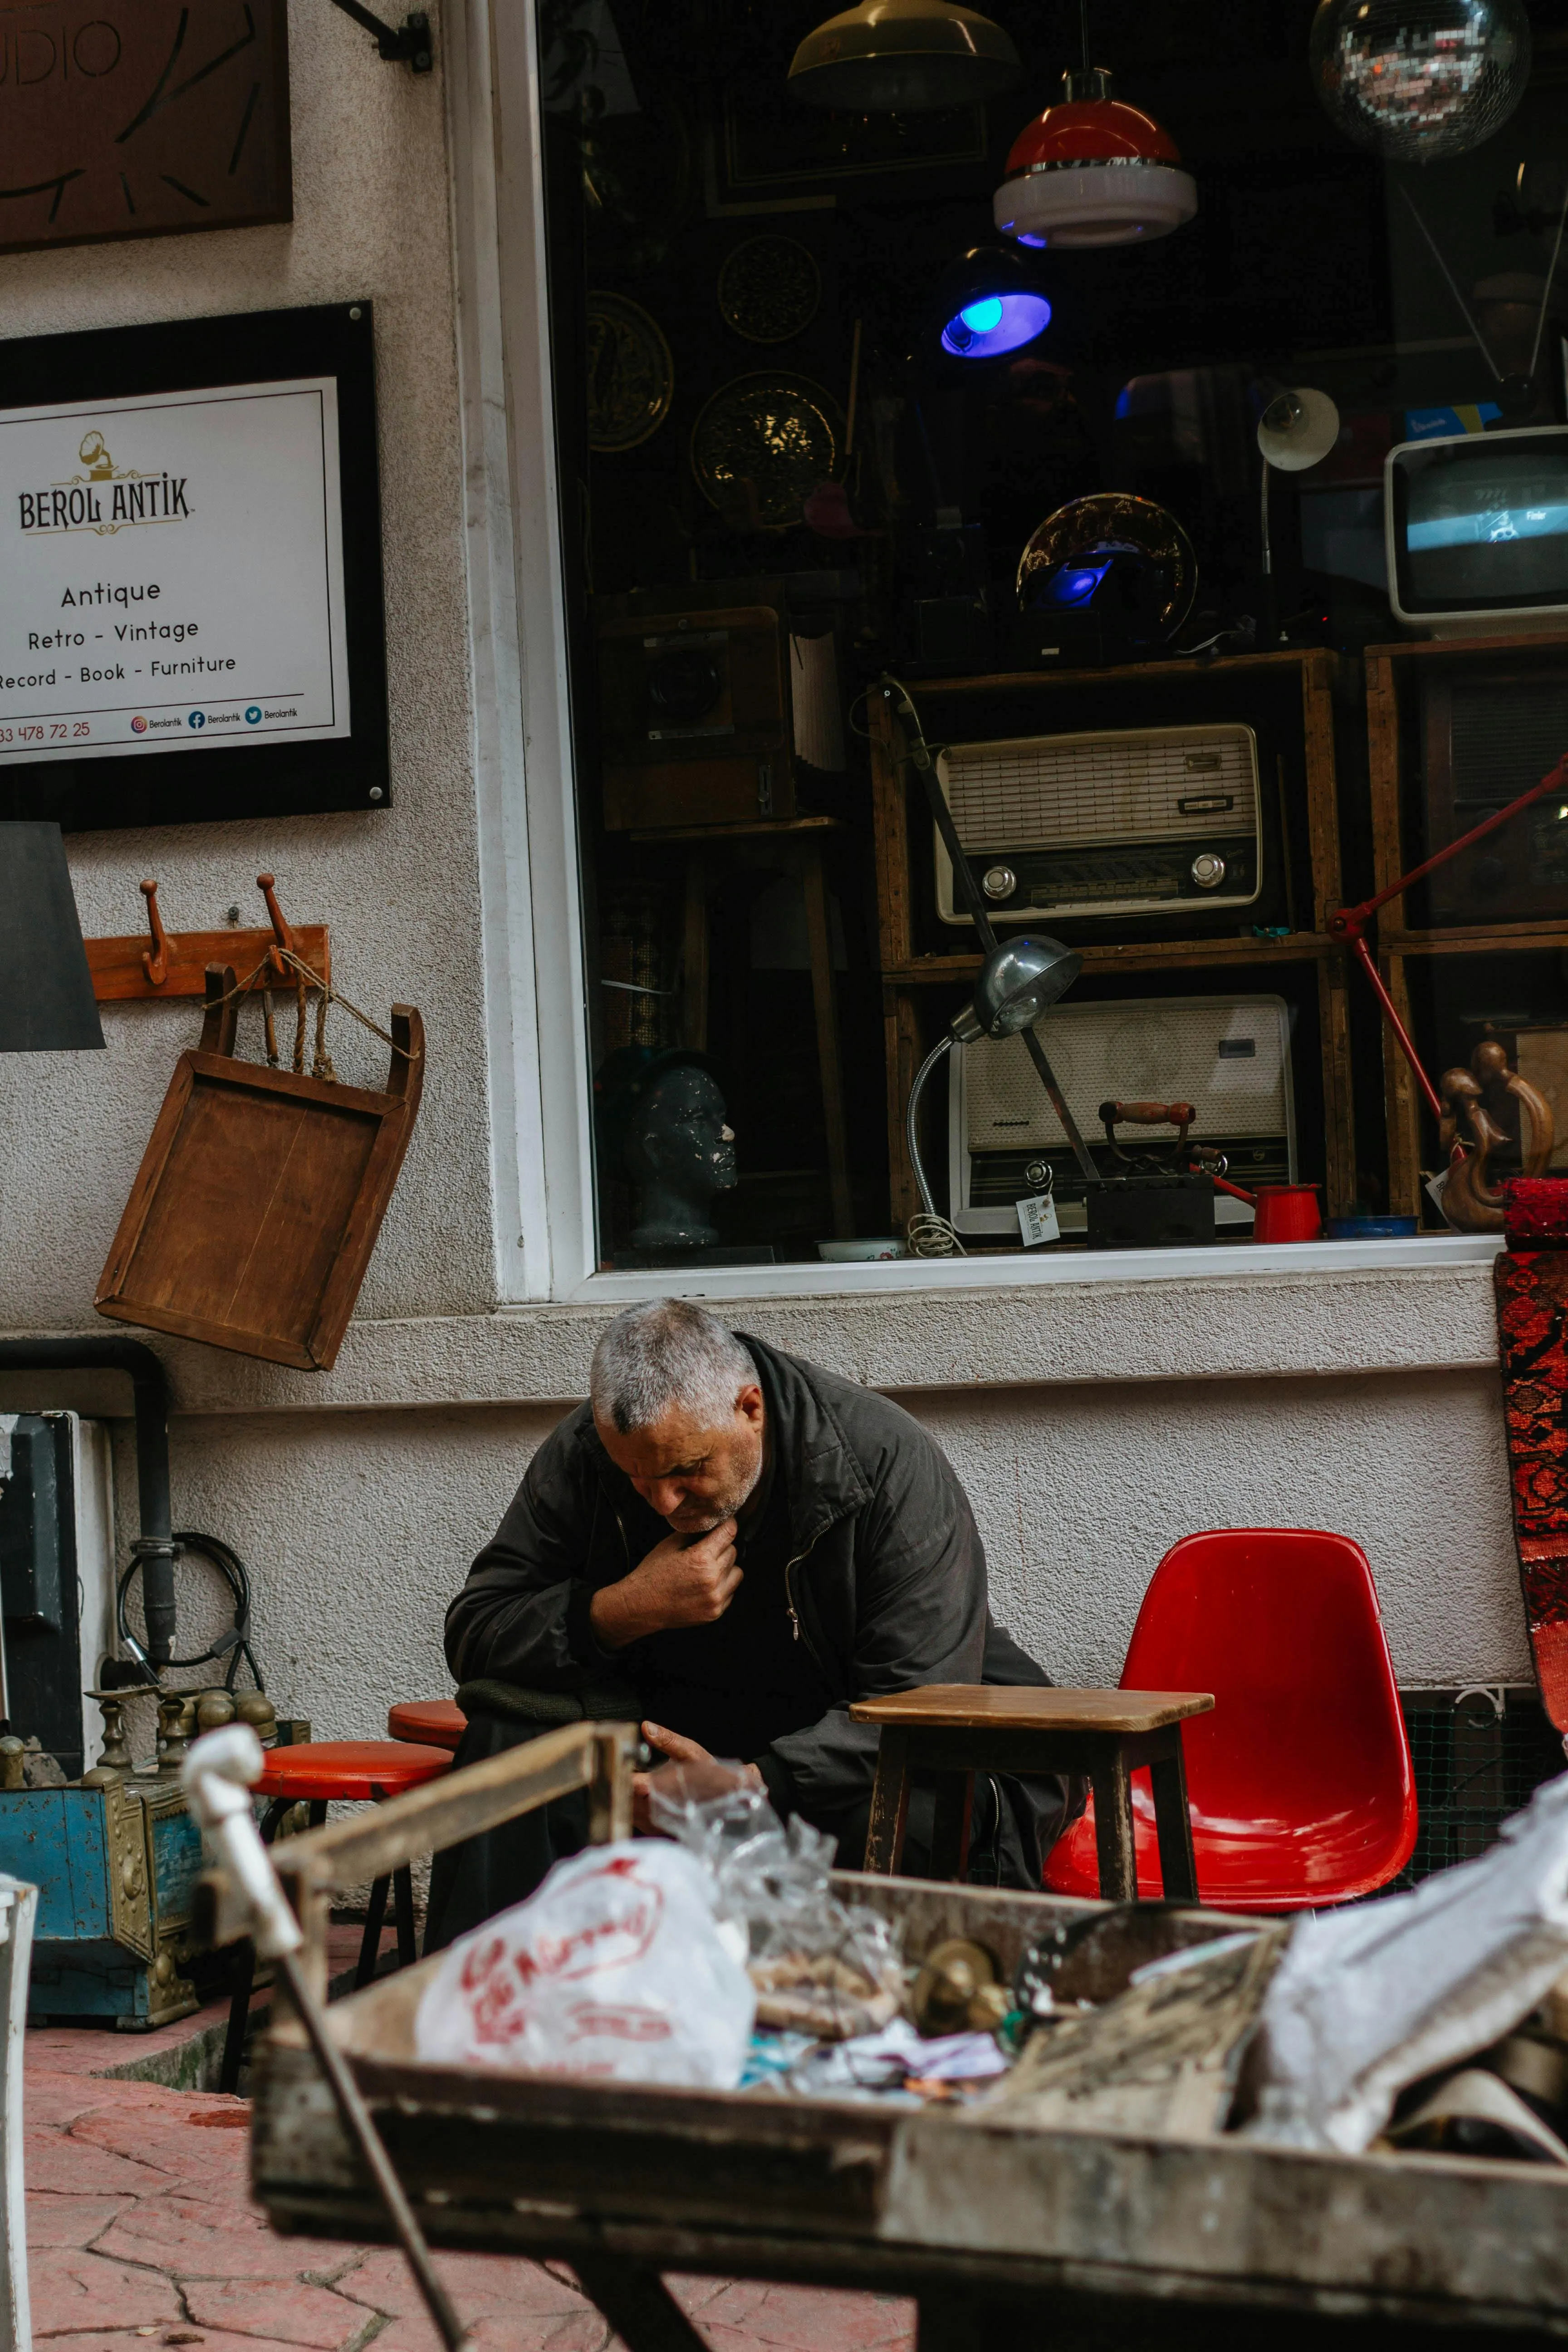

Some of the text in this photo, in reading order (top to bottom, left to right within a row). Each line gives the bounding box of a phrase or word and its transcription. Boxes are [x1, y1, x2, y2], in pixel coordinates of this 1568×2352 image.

[18, 487, 102, 530] BEROL
[111, 472, 190, 524] ANTİK
[61, 583, 161, 609] Antique
[29, 629, 85, 650] Retro
[114, 621, 199, 642] Vintage
[81, 663, 125, 682] Book
[152, 656, 236, 676] Furniture
[149, 717, 182, 729] Berolantik
[208, 713, 240, 724] Berolantik
[264, 708, 298, 719] Berolantik
[19, 726, 44, 741] 478
[50, 724, 67, 739] 72
[73, 722, 90, 737] 25
[1026, 1203, 1039, 1222] BEROL
